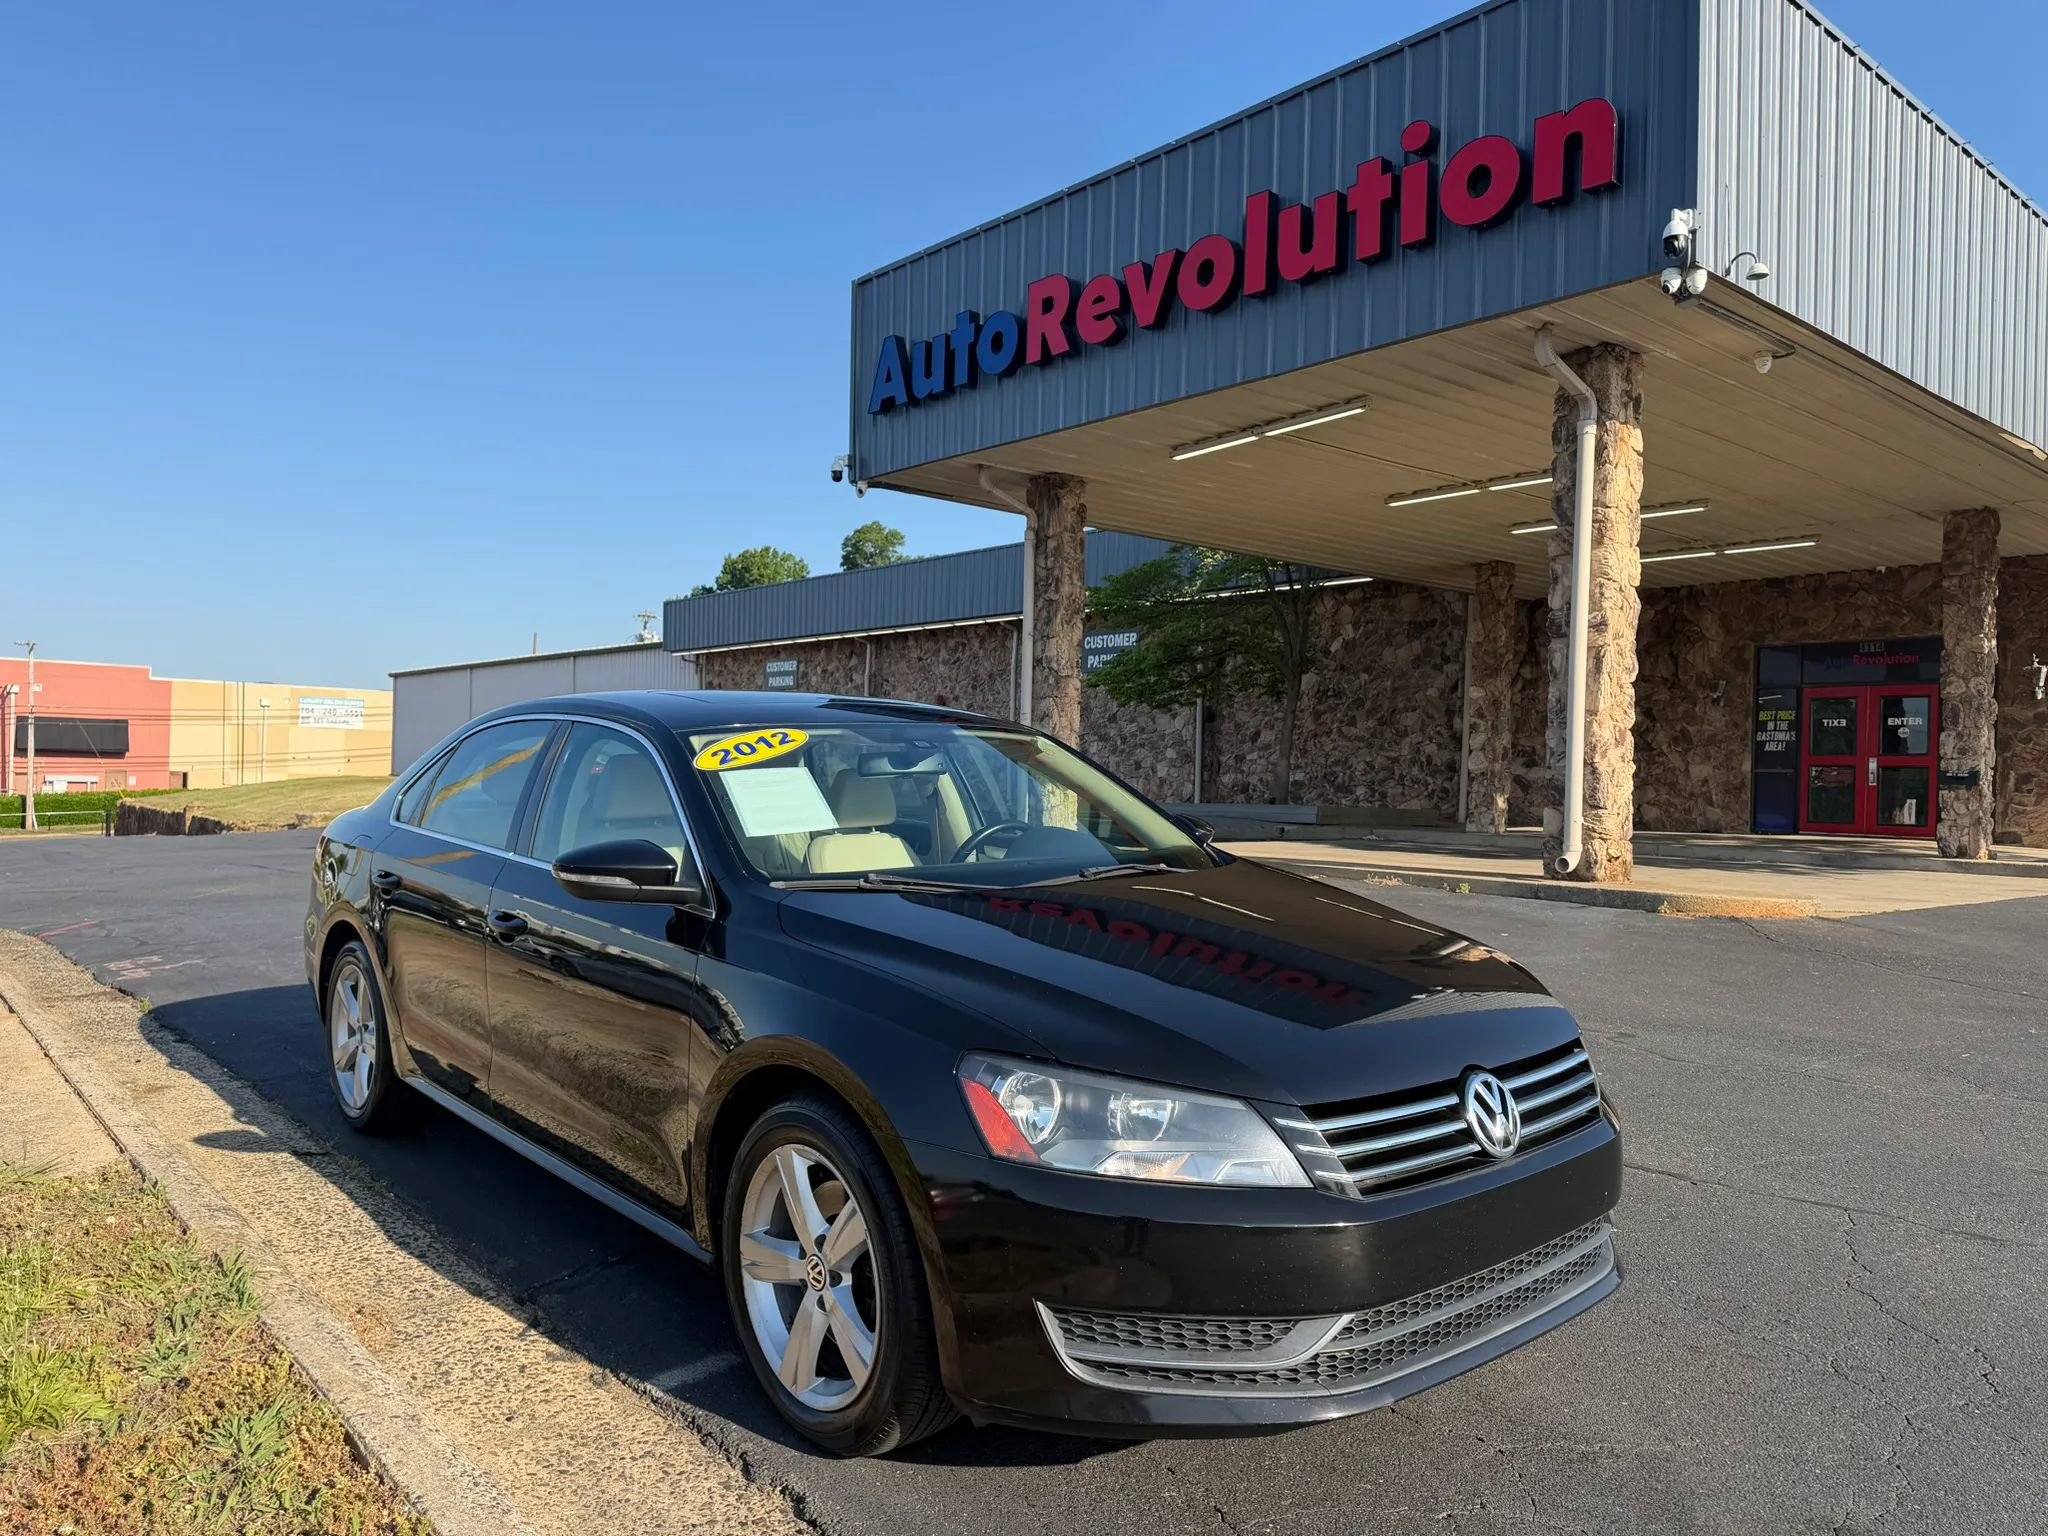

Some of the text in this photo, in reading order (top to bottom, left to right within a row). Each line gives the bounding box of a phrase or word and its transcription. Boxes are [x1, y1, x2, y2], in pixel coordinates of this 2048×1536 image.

[1084, 632, 1137, 649] CUSTOMER
[767, 660, 798, 672] CUSTOMER
[768, 675, 794, 687] PARKING
[1759, 710, 1796, 720] BEST PRICE
[1767, 721, 1790, 730] IN THE
[1887, 717, 1923, 726] ENTER
[711, 731, 796, 766] 2012
[1764, 741, 1787, 751] AREA!
